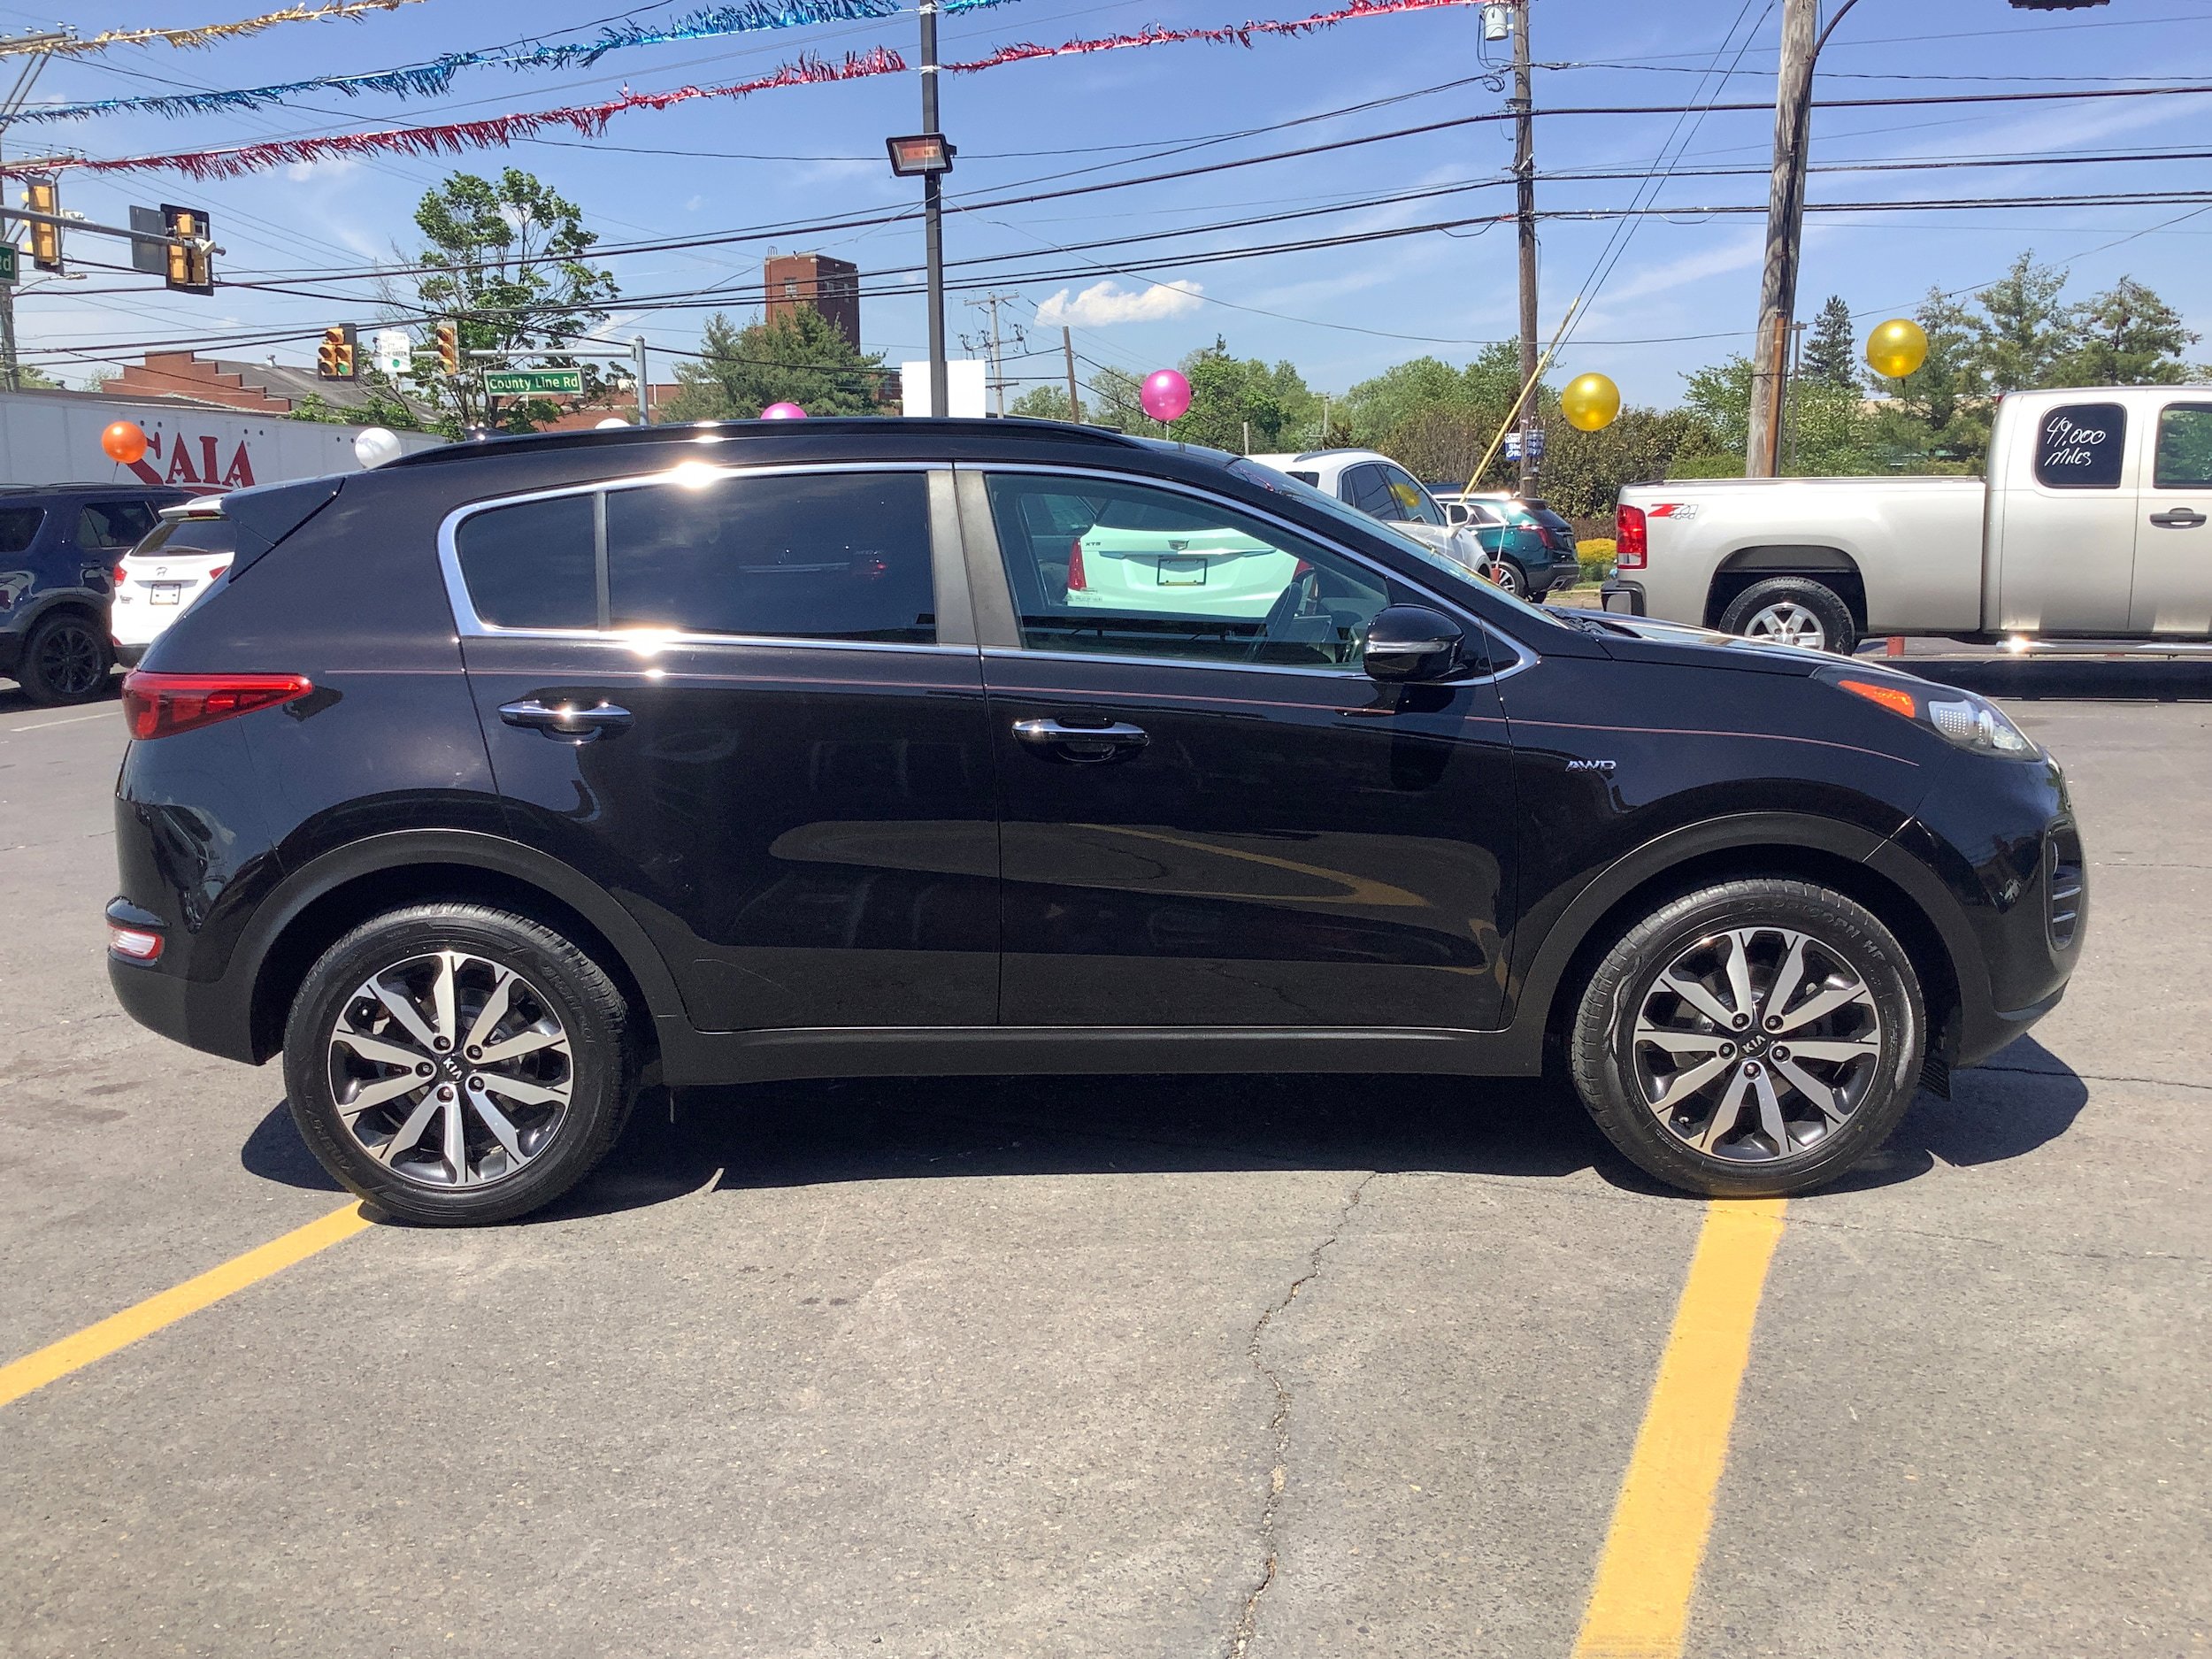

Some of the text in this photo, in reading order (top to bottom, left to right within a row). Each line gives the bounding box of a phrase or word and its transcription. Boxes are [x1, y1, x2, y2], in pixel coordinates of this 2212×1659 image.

[489, 376, 578, 391] County Line Rd
[1565, 760, 1617, 772] AWD
[1741, 1034, 1766, 1053] KIA
[442, 1057, 463, 1079] KIA
